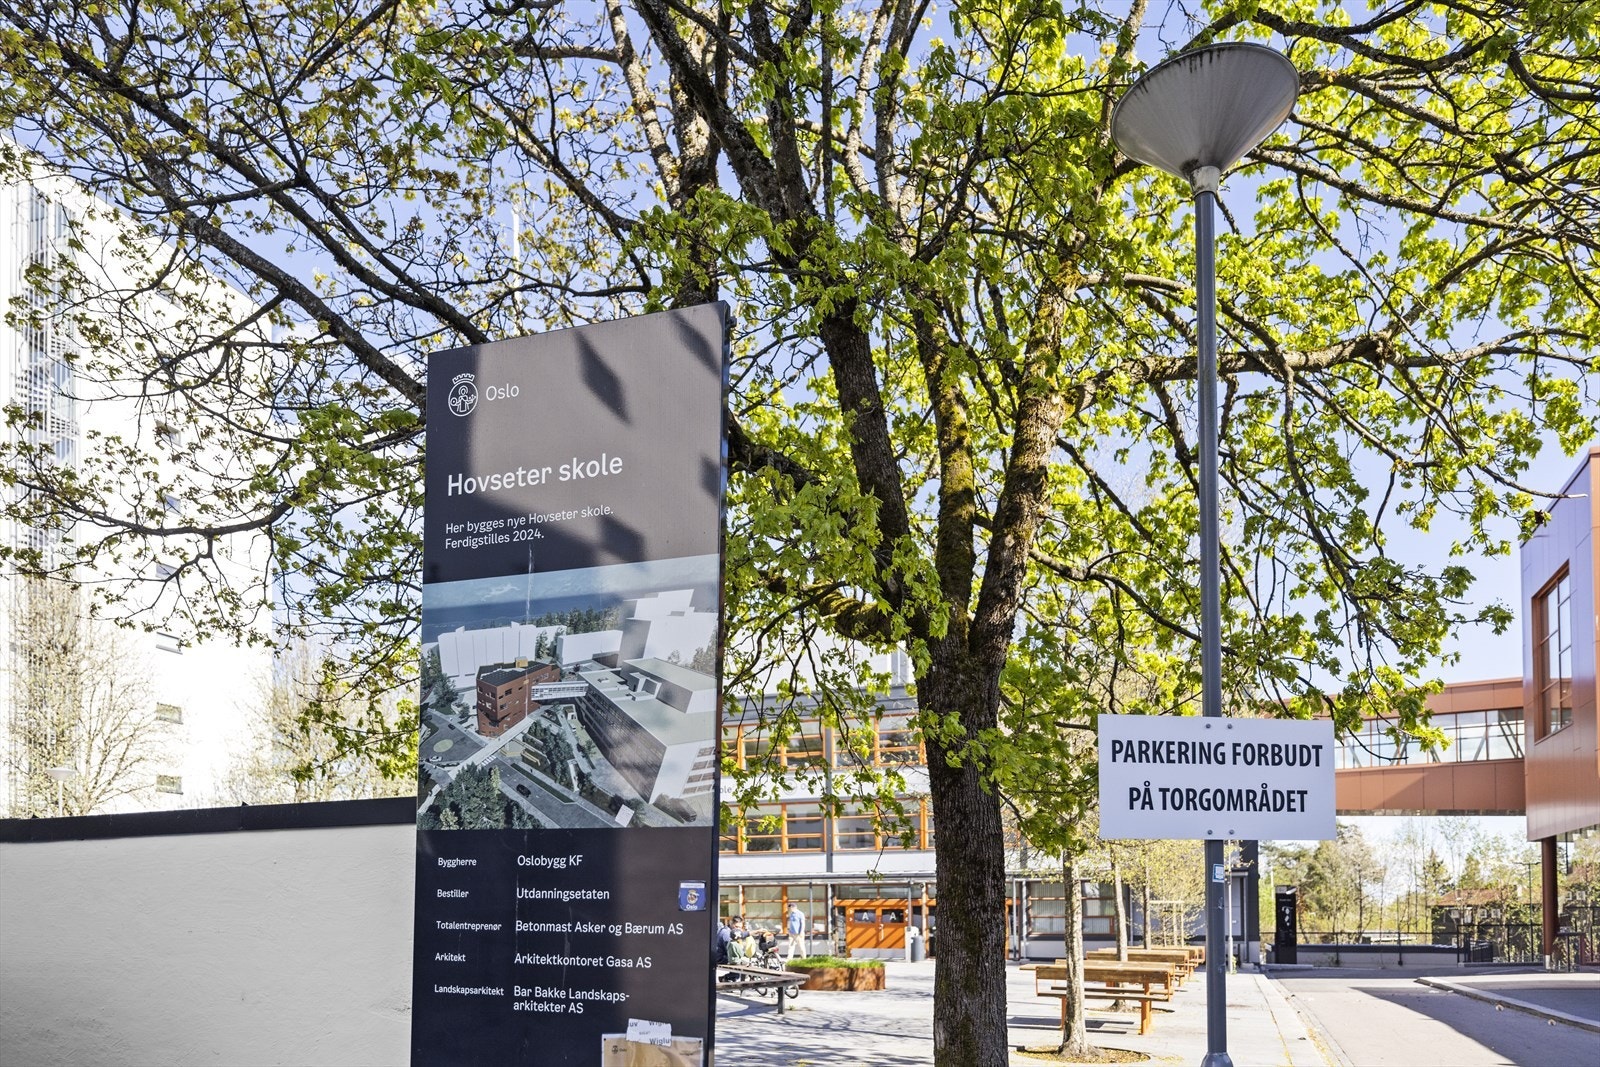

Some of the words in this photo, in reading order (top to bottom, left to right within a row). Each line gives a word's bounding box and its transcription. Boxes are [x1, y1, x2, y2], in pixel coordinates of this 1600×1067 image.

[485, 383, 520, 401] Oslo
[447, 466, 552, 497] Hovseter
[558, 453, 623, 482] skole
[445, 522, 465, 534] Her
[467, 517, 504, 533] bygges
[507, 515, 526, 529] nye
[528, 509, 579, 525] Hovseter
[581, 504, 614, 518] skole.
[445, 530, 510, 549] Ferdigstilles
[512, 528, 545, 542] 2024.
[1111, 739, 1226, 765] PARKERING
[1232, 742, 1323, 767] FORBUDT
[1129, 780, 1154, 811] PÅ
[1158, 782, 1308, 812] TORGOMRÅDET
[438, 857, 477, 868] Byggherre
[517, 855, 567, 869] Oslobygg
[568, 854, 583, 866] KF
[436, 889, 469, 898] Bestiller
[516, 887, 610, 902] Utdanningsetaten
[862, 912, 869, 920] A
[890, 912, 897, 920] A
[436, 920, 502, 932] Totalentreprenør
[515, 920, 572, 933] Betonmast
[574, 921, 606, 934] Asker
[608, 924, 622, 936] og
[624, 922, 665, 935] Bærum
[667, 923, 684, 935] AS
[434, 952, 466, 962] Arkitekt
[514, 953, 604, 967] Arkitektkontoret
[606, 956, 633, 968] Gasa
[635, 957, 652, 968] AS
[434, 984, 504, 996] Landskapsarkitekt
[513, 985, 532, 998] Bar
[534, 986, 566, 999] Bakke
[568, 988, 630, 1004] Landskaps-
[513, 1000, 566, 1013] arkitekter
[568, 1002, 584, 1014] AS
